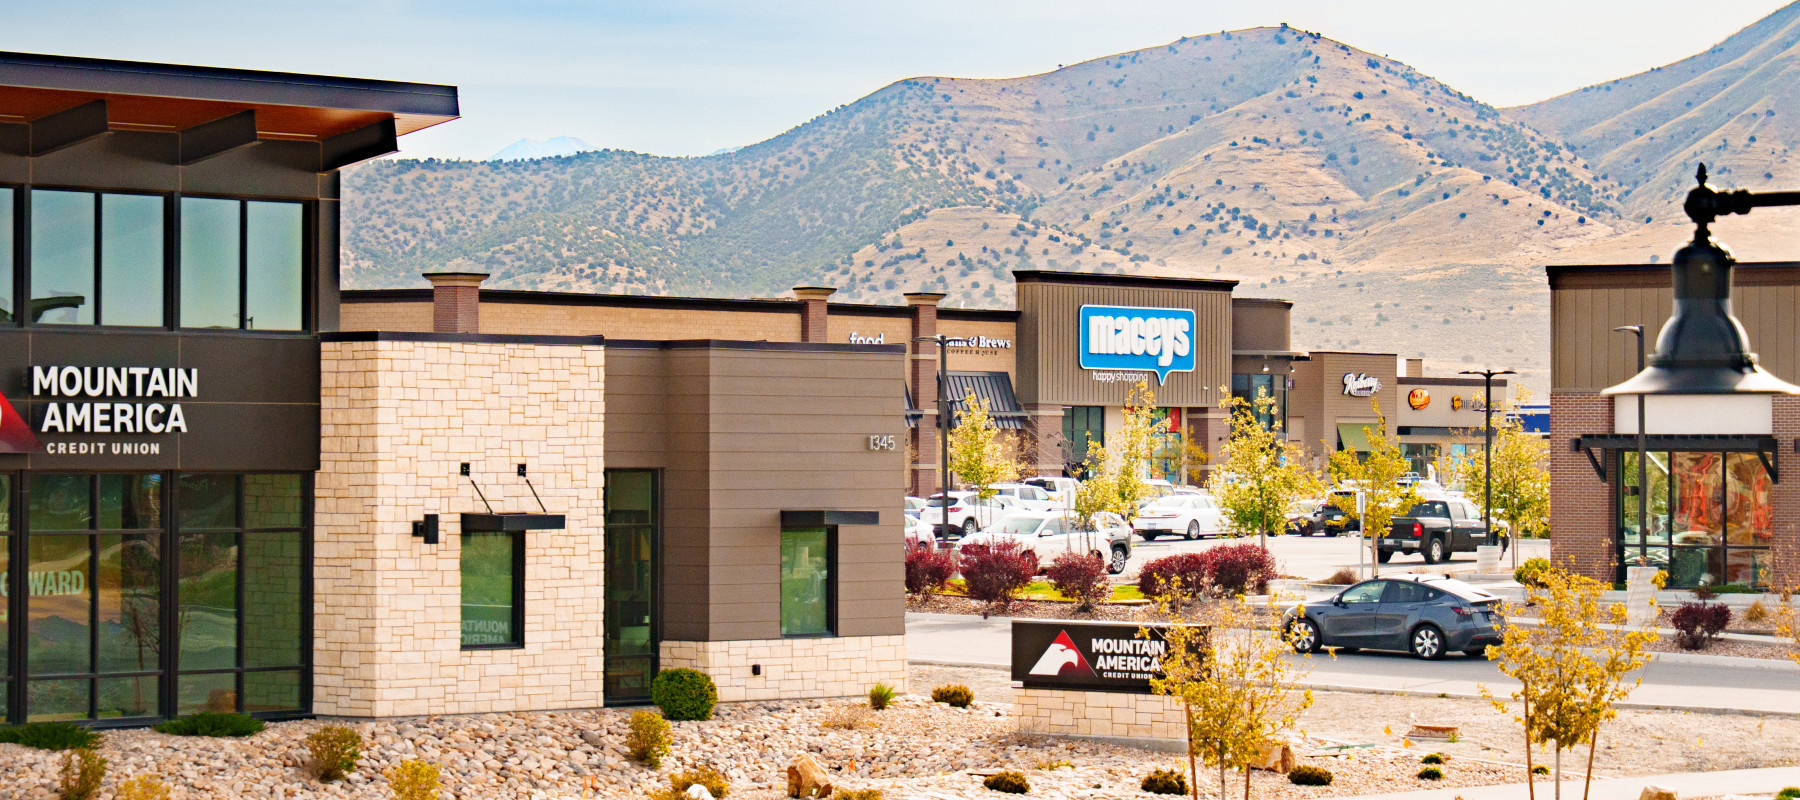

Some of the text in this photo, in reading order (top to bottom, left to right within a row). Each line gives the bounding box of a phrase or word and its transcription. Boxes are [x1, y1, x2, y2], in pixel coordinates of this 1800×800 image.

[850, 332, 883, 344] food
[936, 334, 967, 347] ans
[978, 336, 1011, 348] Brews
[1088, 315, 1190, 367] maceys
[33, 366, 198, 397] MOUNTAIN
[41, 403, 188, 433] AMERICA
[46, 443, 160, 455] CREDIT UNION
[870, 435, 896, 450] 1345
[1092, 638, 1165, 655] MOUNTAIN
[1095, 655, 1161, 671] AMERICA
